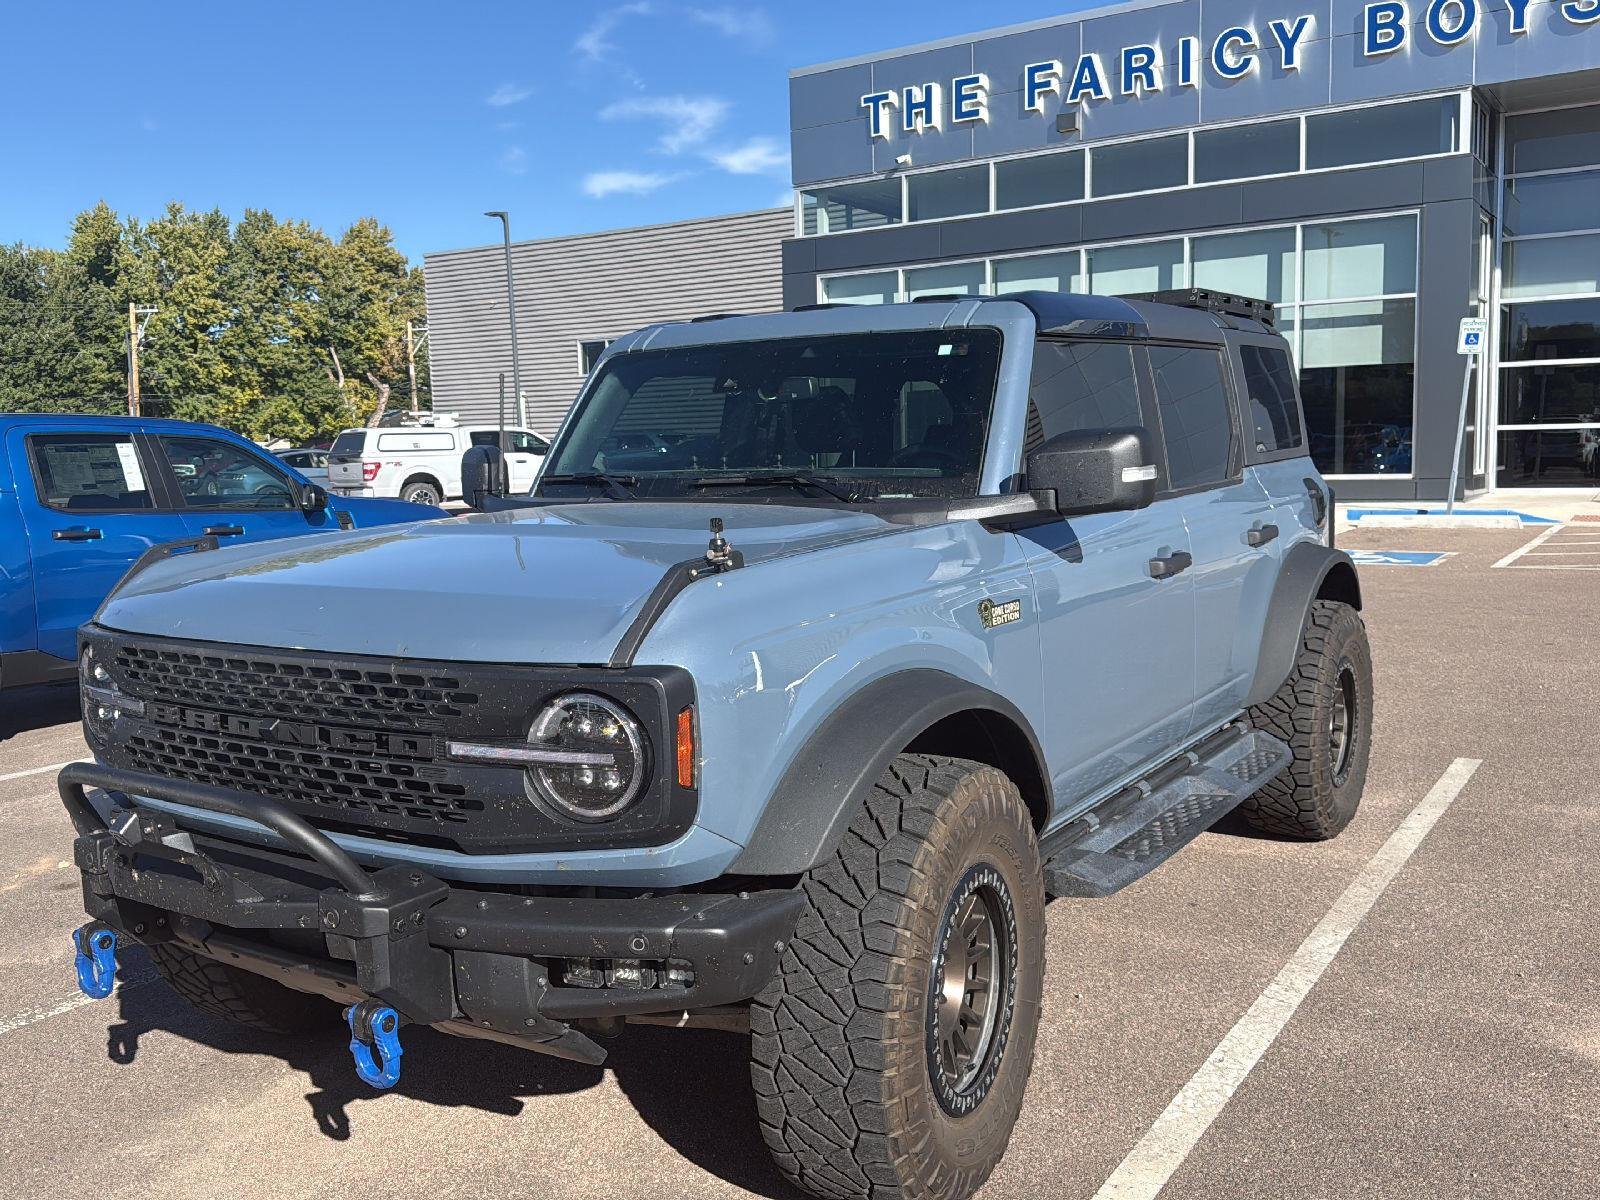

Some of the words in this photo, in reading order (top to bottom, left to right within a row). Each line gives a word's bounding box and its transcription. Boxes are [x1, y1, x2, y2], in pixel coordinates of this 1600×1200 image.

[861, 74, 989, 141] THE
[1025, 14, 1315, 112] FARICY
[992, 611, 1020, 626] EDITION
[150, 703, 432, 757] BRONCO
